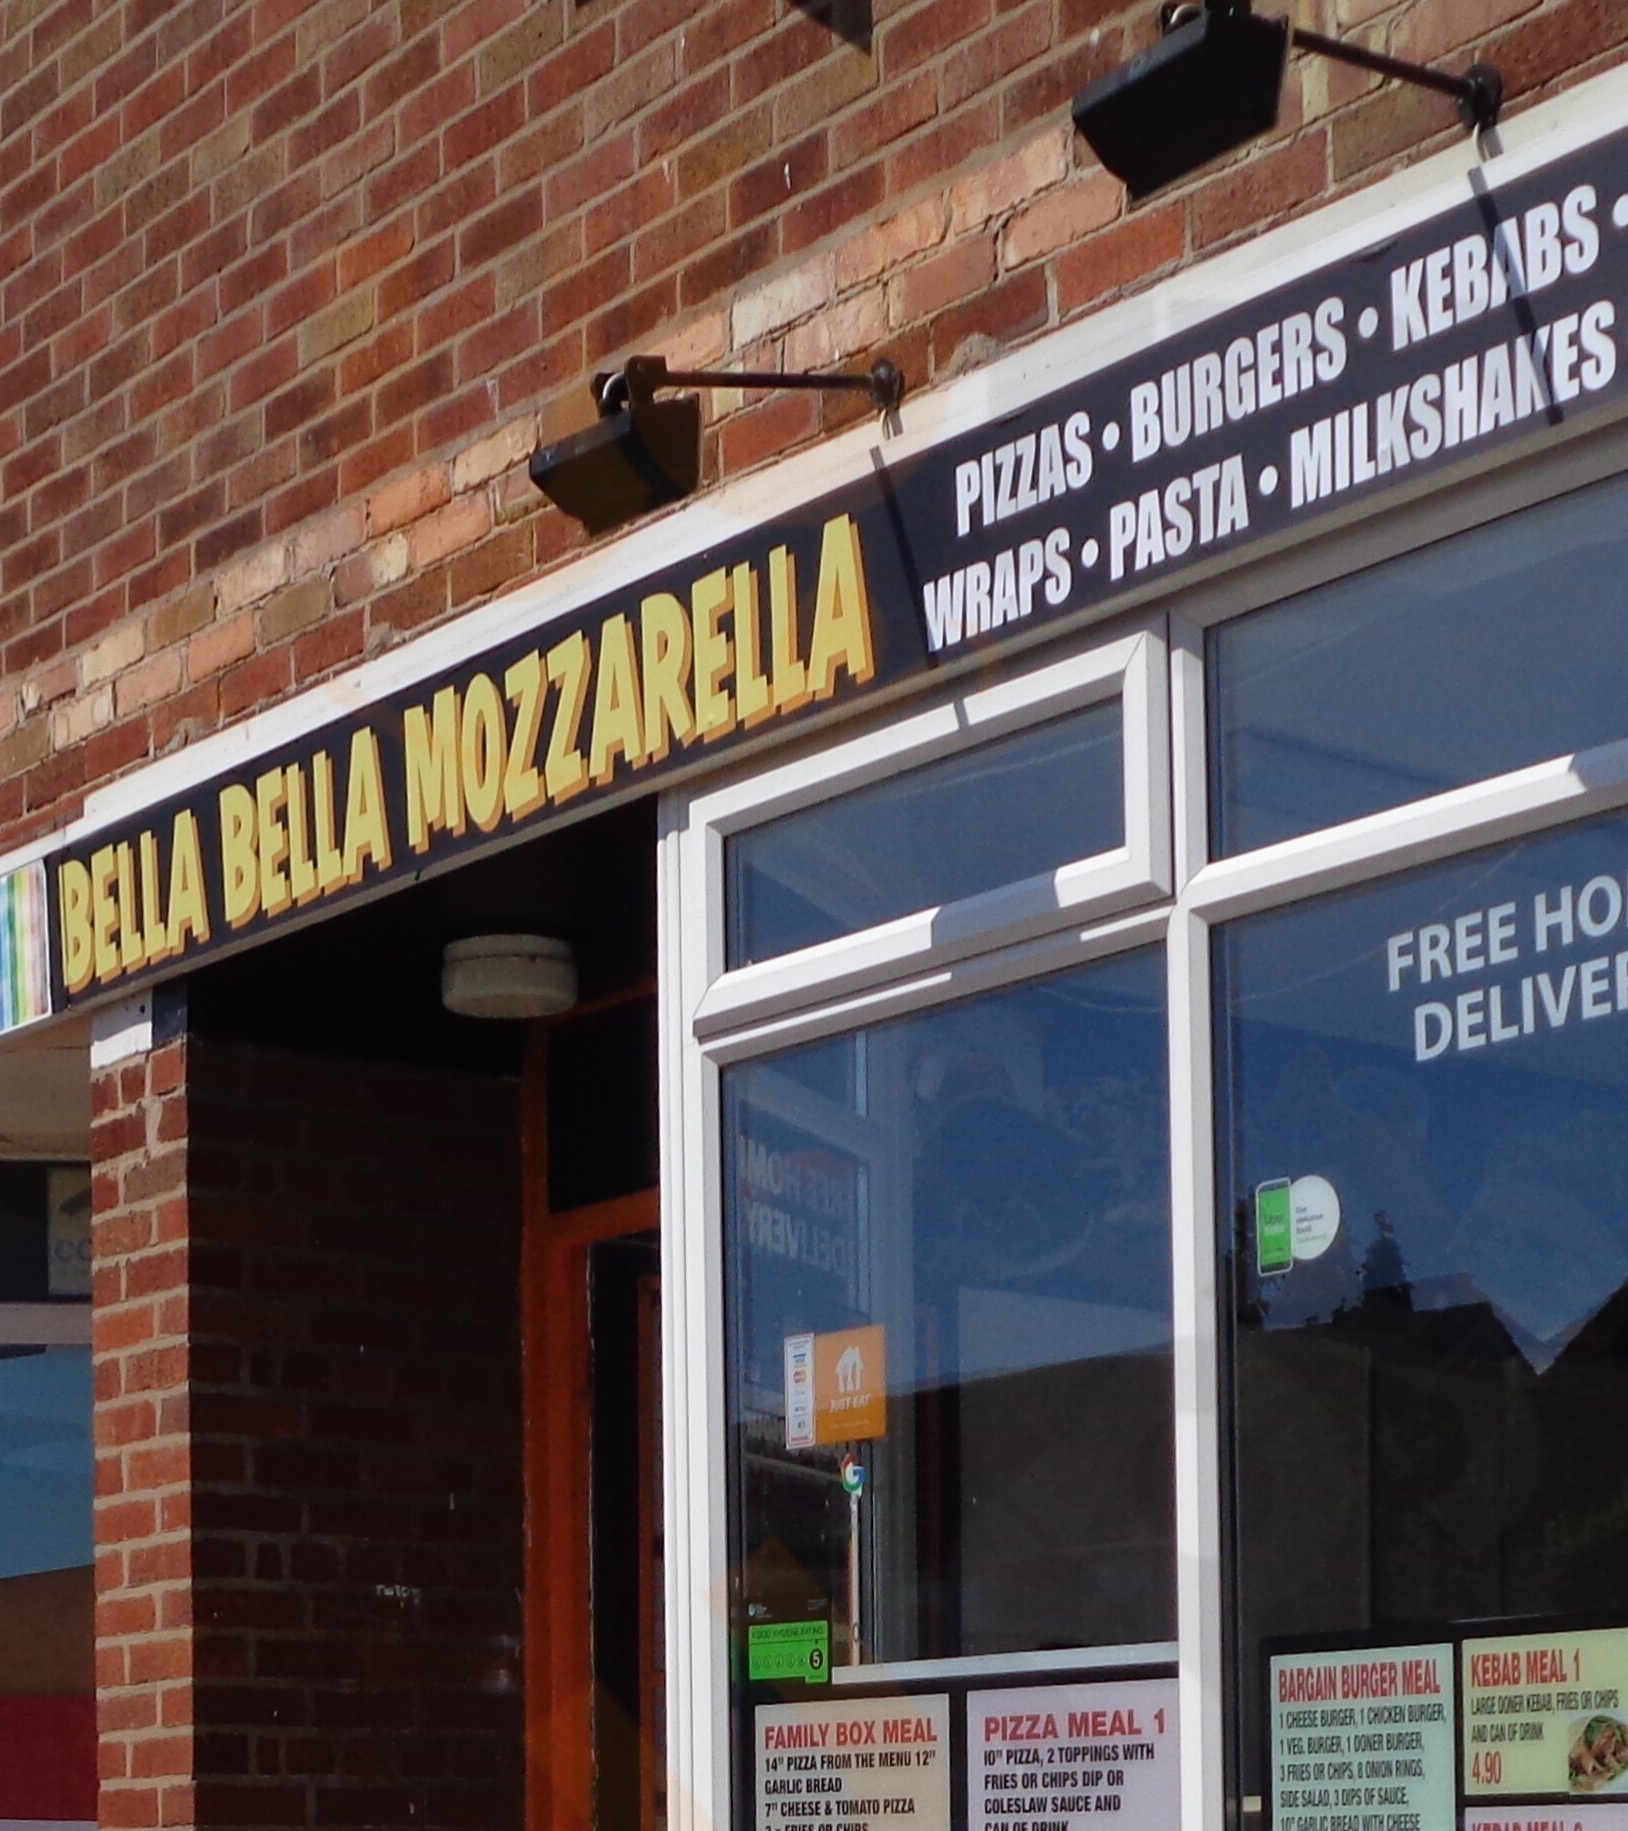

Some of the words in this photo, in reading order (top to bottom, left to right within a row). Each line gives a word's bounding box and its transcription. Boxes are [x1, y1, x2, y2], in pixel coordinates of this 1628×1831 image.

[954, 411, 1095, 538] PIZZAS
[1129, 296, 1348, 463] BURGERS
[1389, 184, 1601, 349] KEBABS
[923, 529, 1074, 654] WRAPS
[1108, 465, 1251, 583] PASTA
[1288, 311, 1618, 512] MILKSHAKES
[58, 808, 210, 995] BELLA
[219, 725, 392, 930] BELLA
[403, 512, 876, 855] MOZZARELLA
[1387, 901, 1518, 992] FREE
[1279, 1665, 1338, 1703] BARGAIN
[1341, 1662, 1398, 1700] BURGER
[1403, 1659, 1441, 1695] MEAL
[1471, 1651, 1522, 1688] KEBAB
[1526, 1649, 1568, 1685] MEAL
[1573, 1650, 1582, 1682] 1
[764, 1723, 830, 1750] FAMILY
[835, 1721, 877, 1746] BOX
[883, 1717, 939, 1744] MEAL
[984, 1714, 1057, 1742] PIZZA
[1067, 1710, 1141, 1739] MEAL
[1153, 1707, 1165, 1734] 1
[787, 1755, 817, 1771] PIZZA
[820, 1754, 852, 1770] FROM
[855, 1753, 876, 1769] THE
[878, 1752, 912, 1768] MENU
[1472, 1750, 1502, 1786] 4.90
[765, 1778, 803, 1795] GARLIC
[805, 1777, 843, 1794] BREAD
